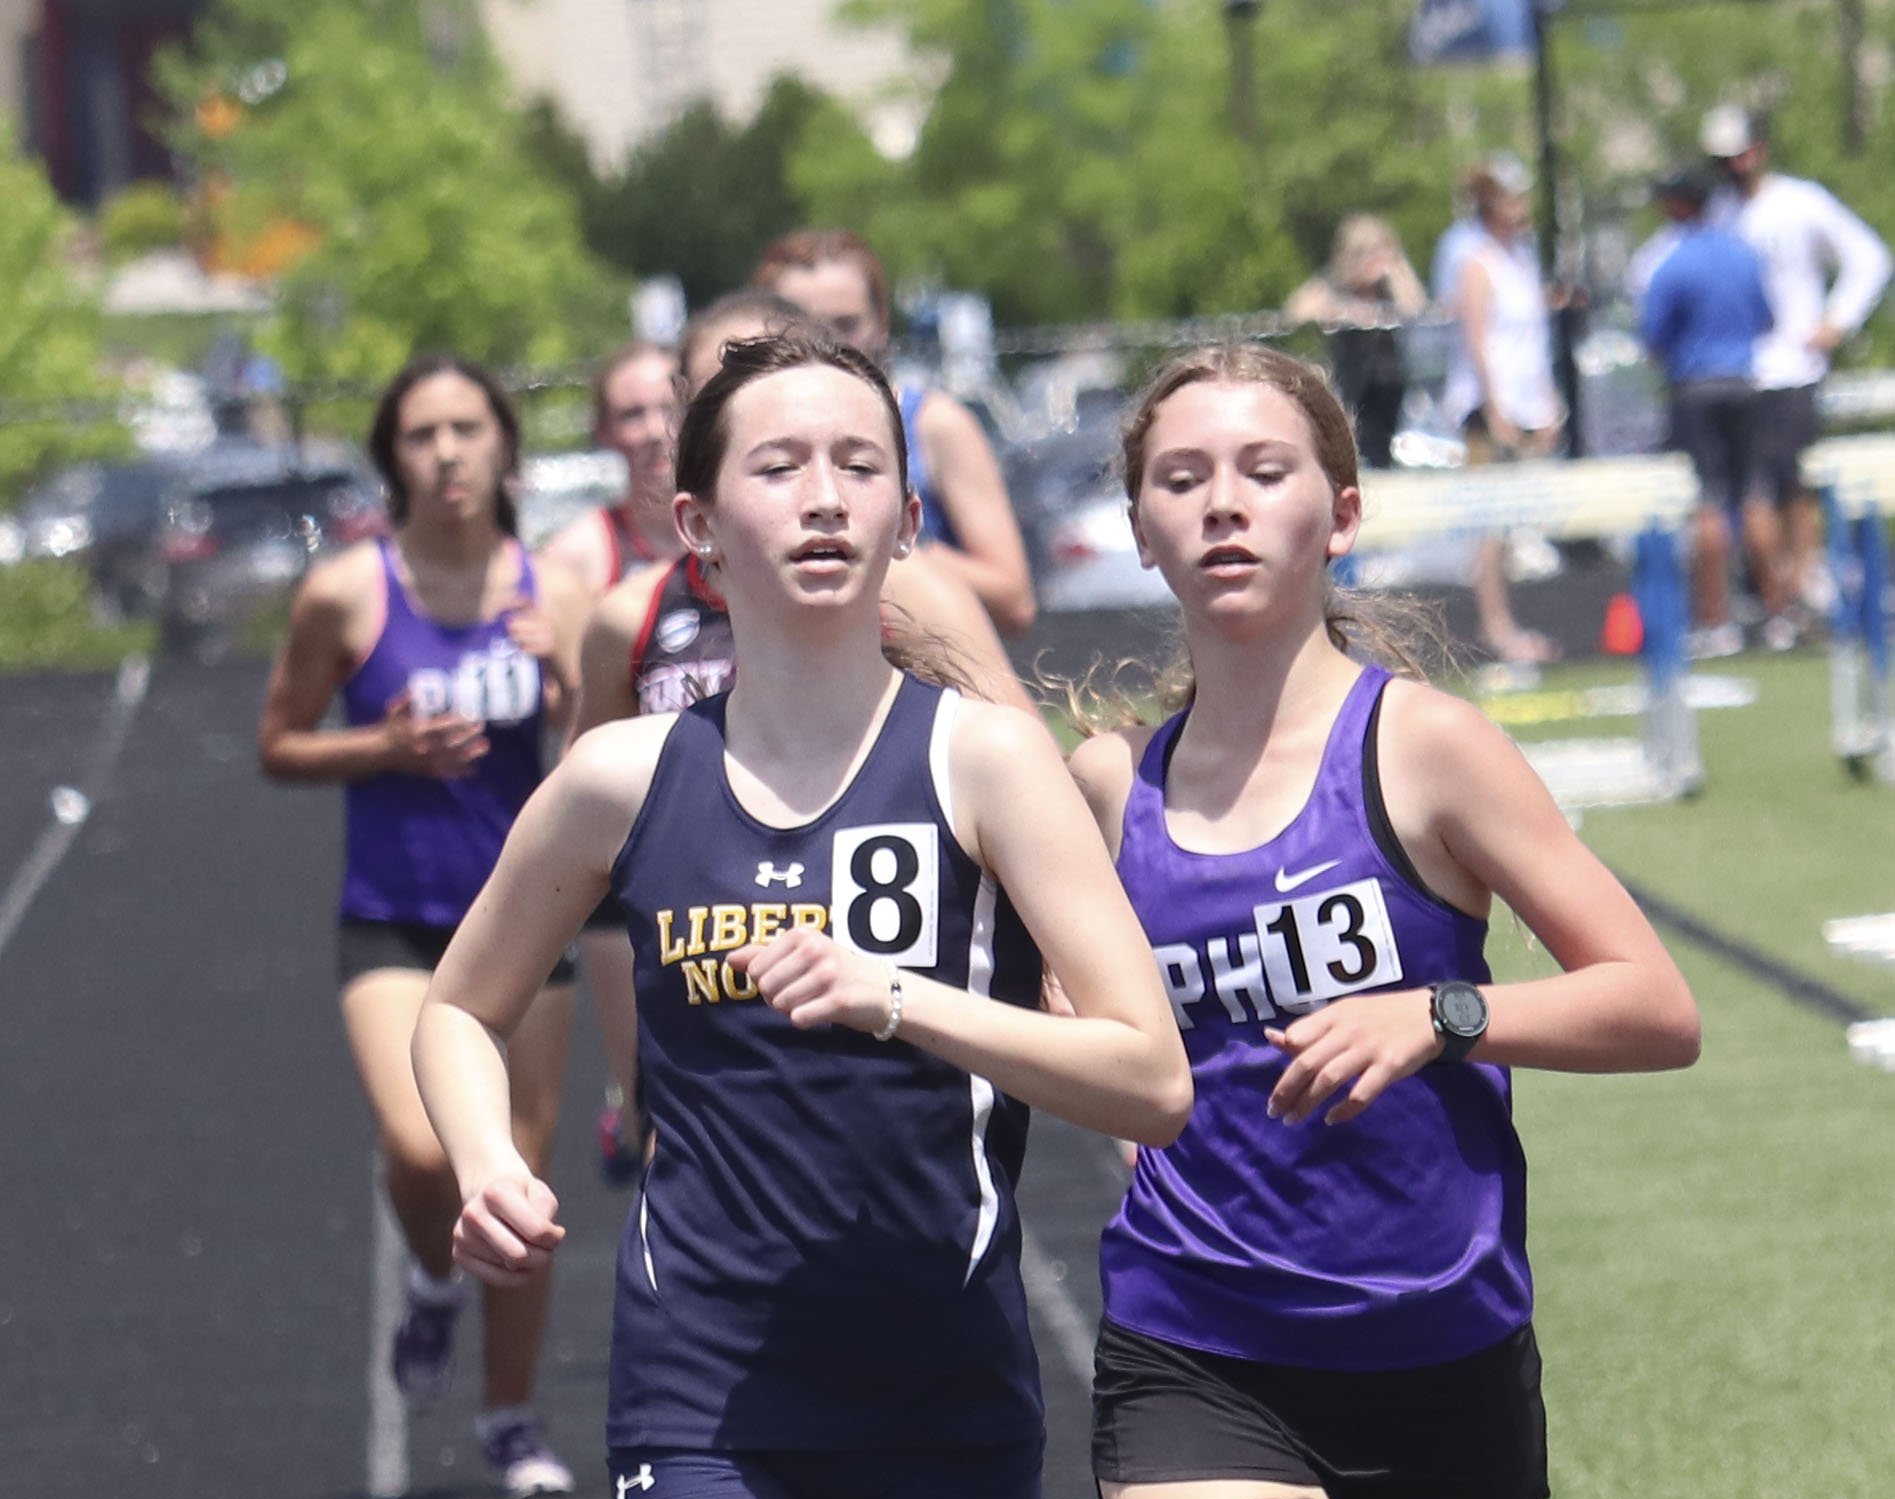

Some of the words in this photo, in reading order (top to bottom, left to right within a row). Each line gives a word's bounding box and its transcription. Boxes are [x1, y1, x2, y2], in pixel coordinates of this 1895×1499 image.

[656, 903, 833, 966] LIBER
[848, 835, 922, 954] 8
[1267, 893, 1378, 996] 13
[1152, 932, 1328, 1031] PH
